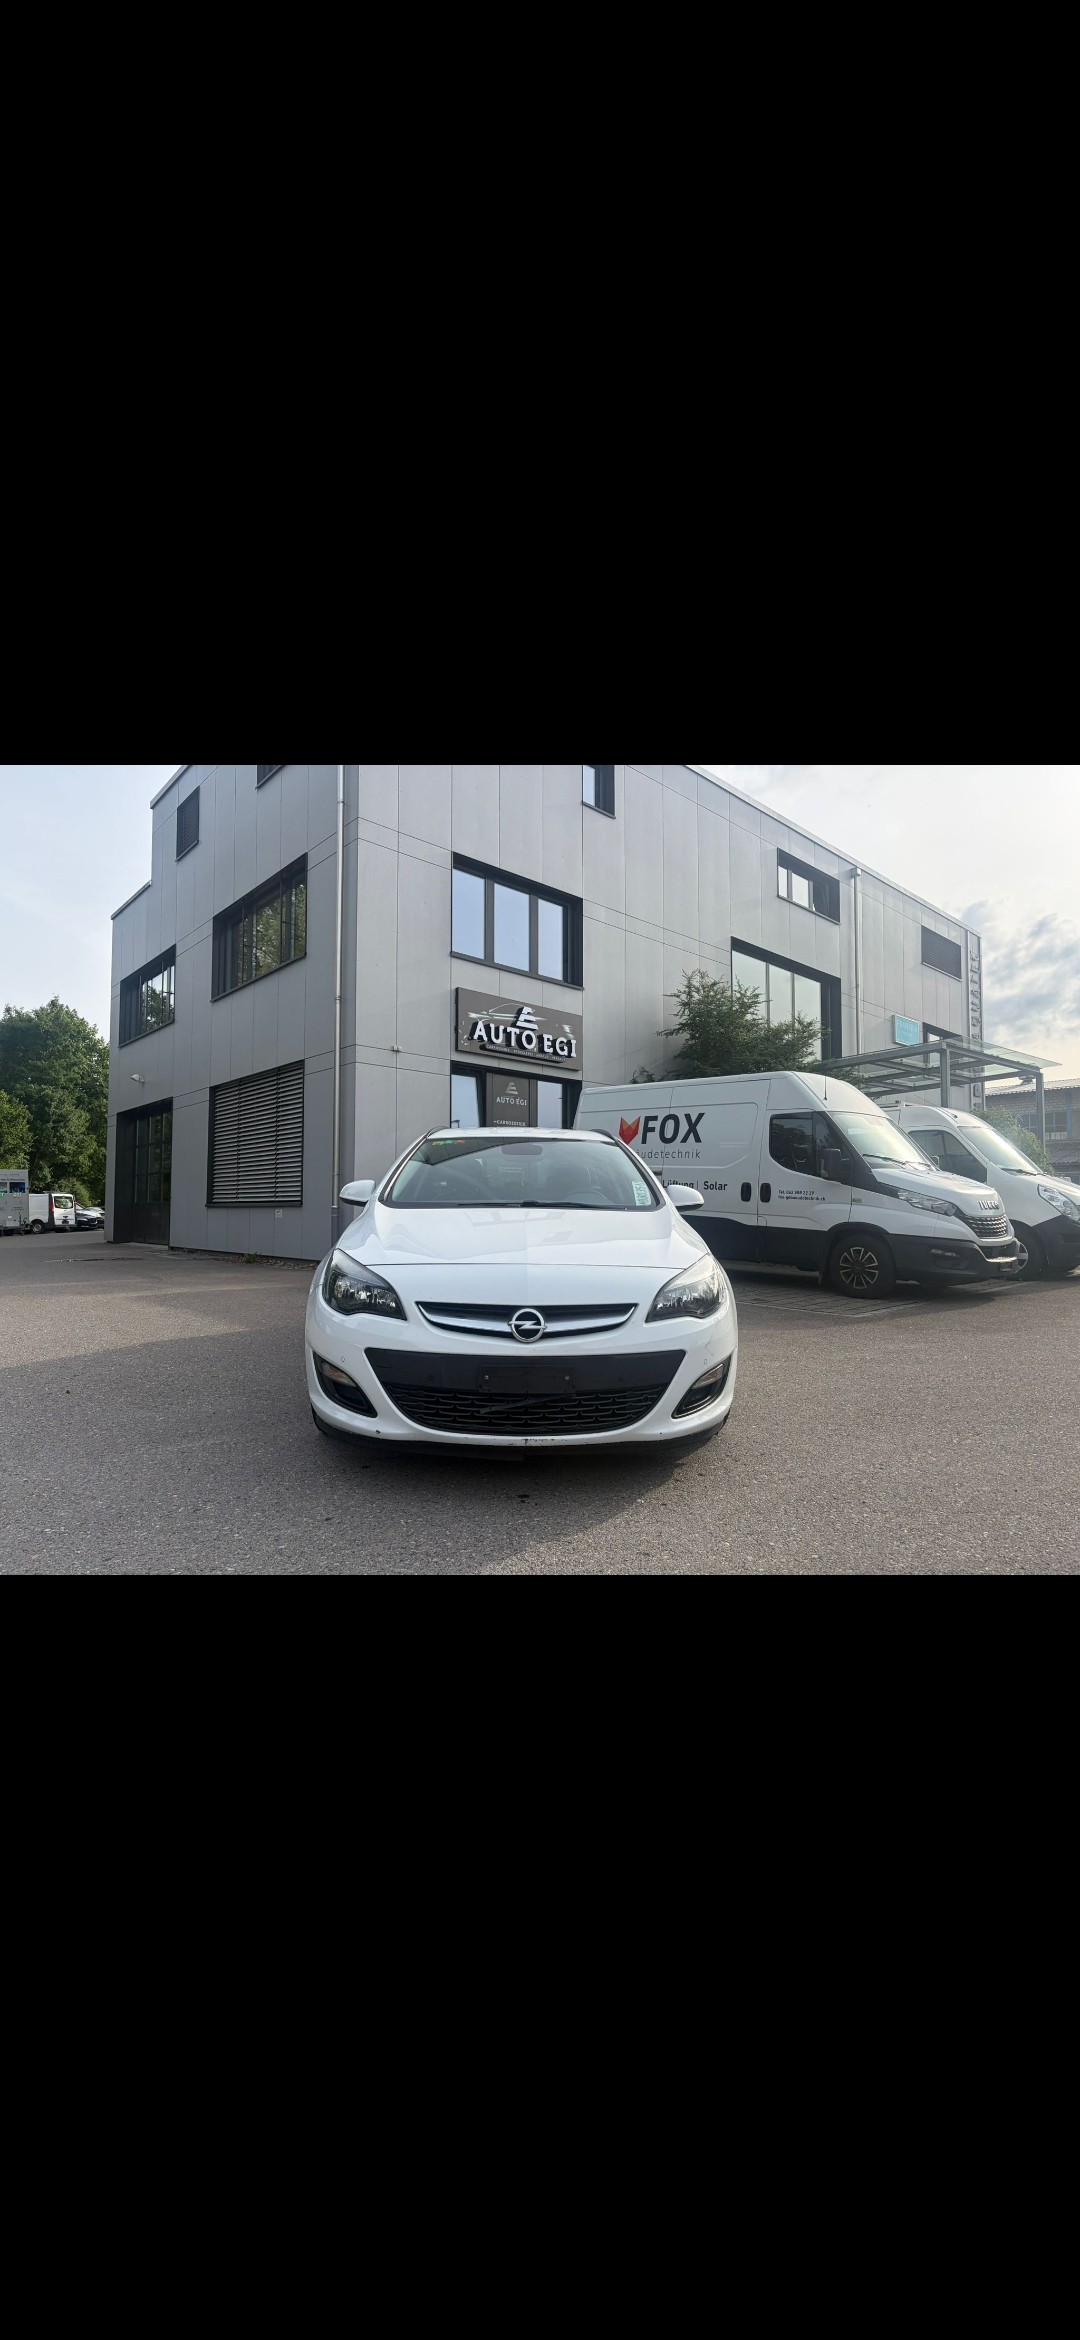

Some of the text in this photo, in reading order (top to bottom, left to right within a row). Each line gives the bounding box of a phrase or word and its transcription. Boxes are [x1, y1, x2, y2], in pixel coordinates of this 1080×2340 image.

[473, 1020, 537, 1050] AUTO
[542, 1033, 577, 1058] EGI
[495, 1096, 515, 1105] AUTO
[641, 1112, 705, 1145] FOX
[703, 1180, 728, 1191] Solar
